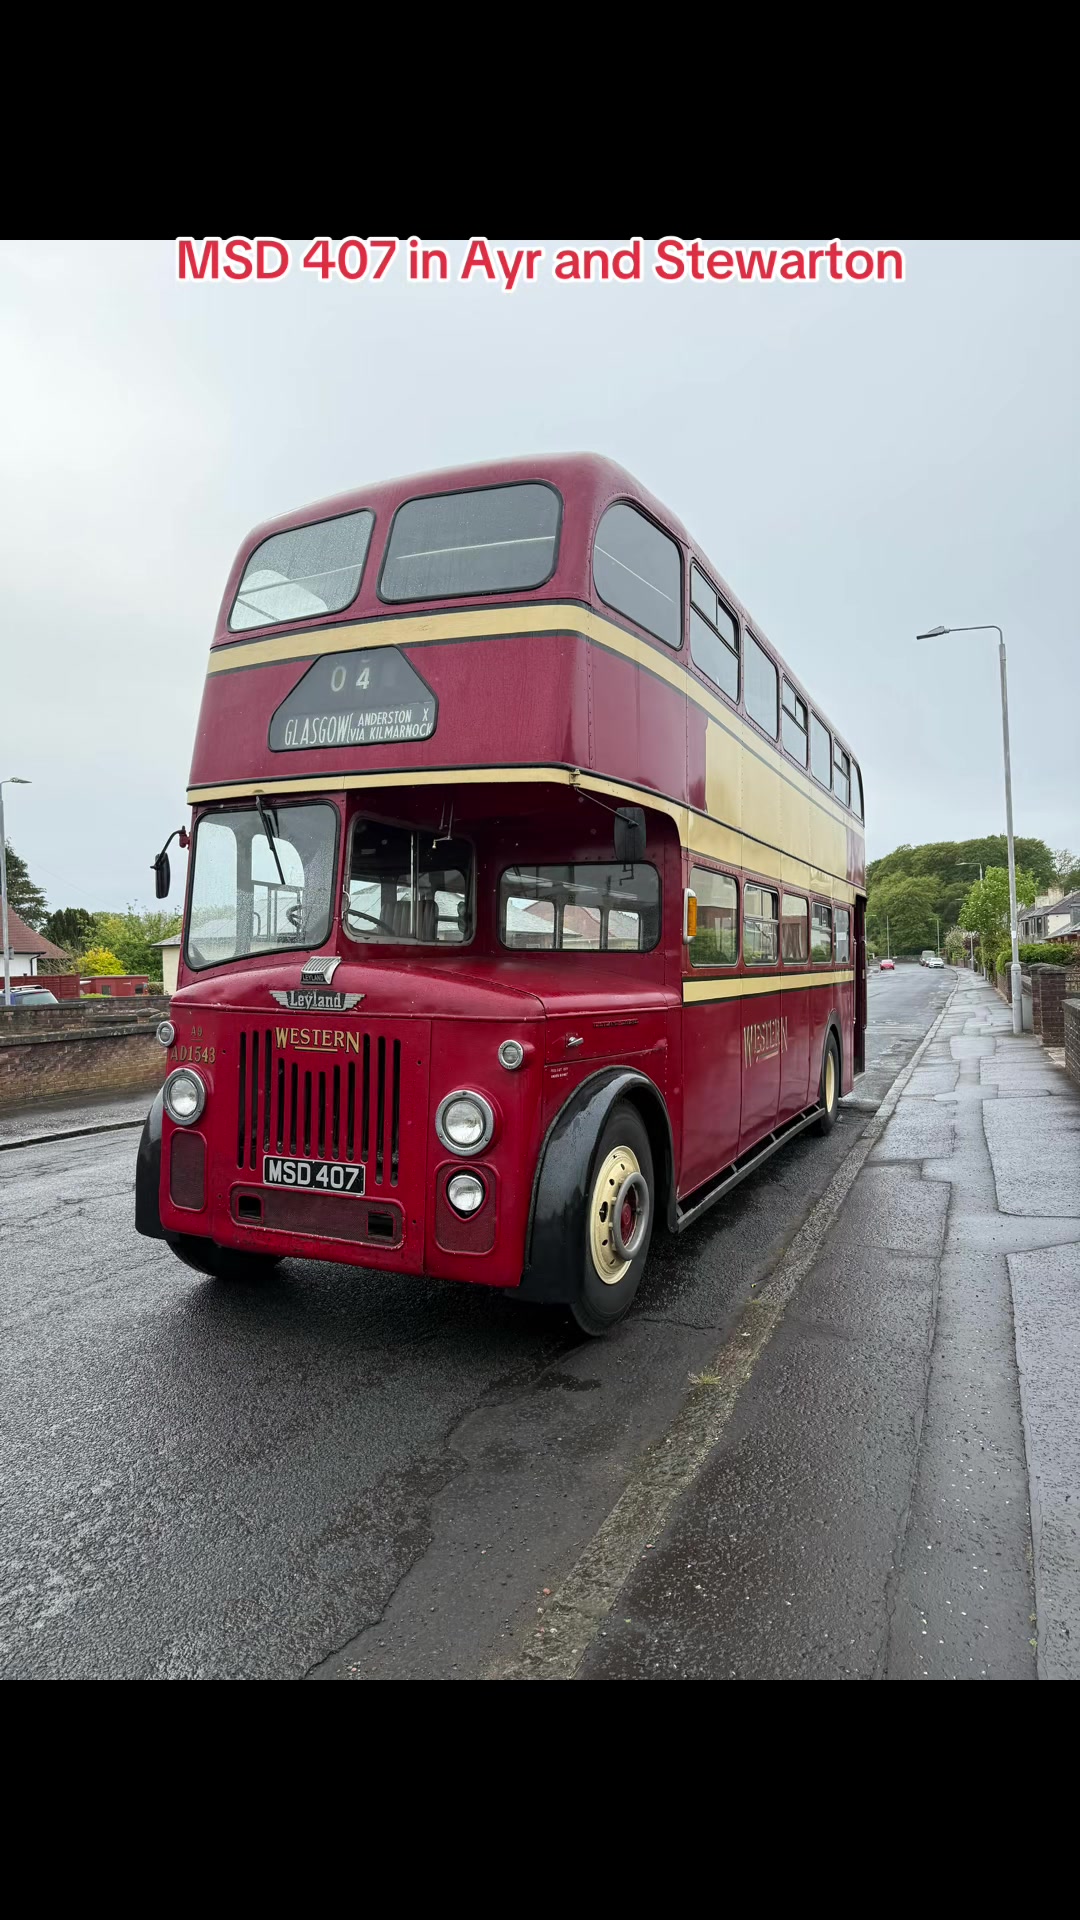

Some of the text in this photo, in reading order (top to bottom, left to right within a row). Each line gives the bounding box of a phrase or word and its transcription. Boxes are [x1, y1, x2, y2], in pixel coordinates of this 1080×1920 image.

[357, 707, 430, 727] ANDERSTON X
[350, 722, 433, 742] VIA KILMARNOCK
[302, 973, 324, 982] LEYLAND
[289, 989, 342, 1010] Leyland
[274, 1026, 361, 1054] WESTERN
[743, 1015, 788, 1069] WESTERN
[171, 1045, 216, 1065] AD1543
[268, 1159, 360, 1191] MSD 407
